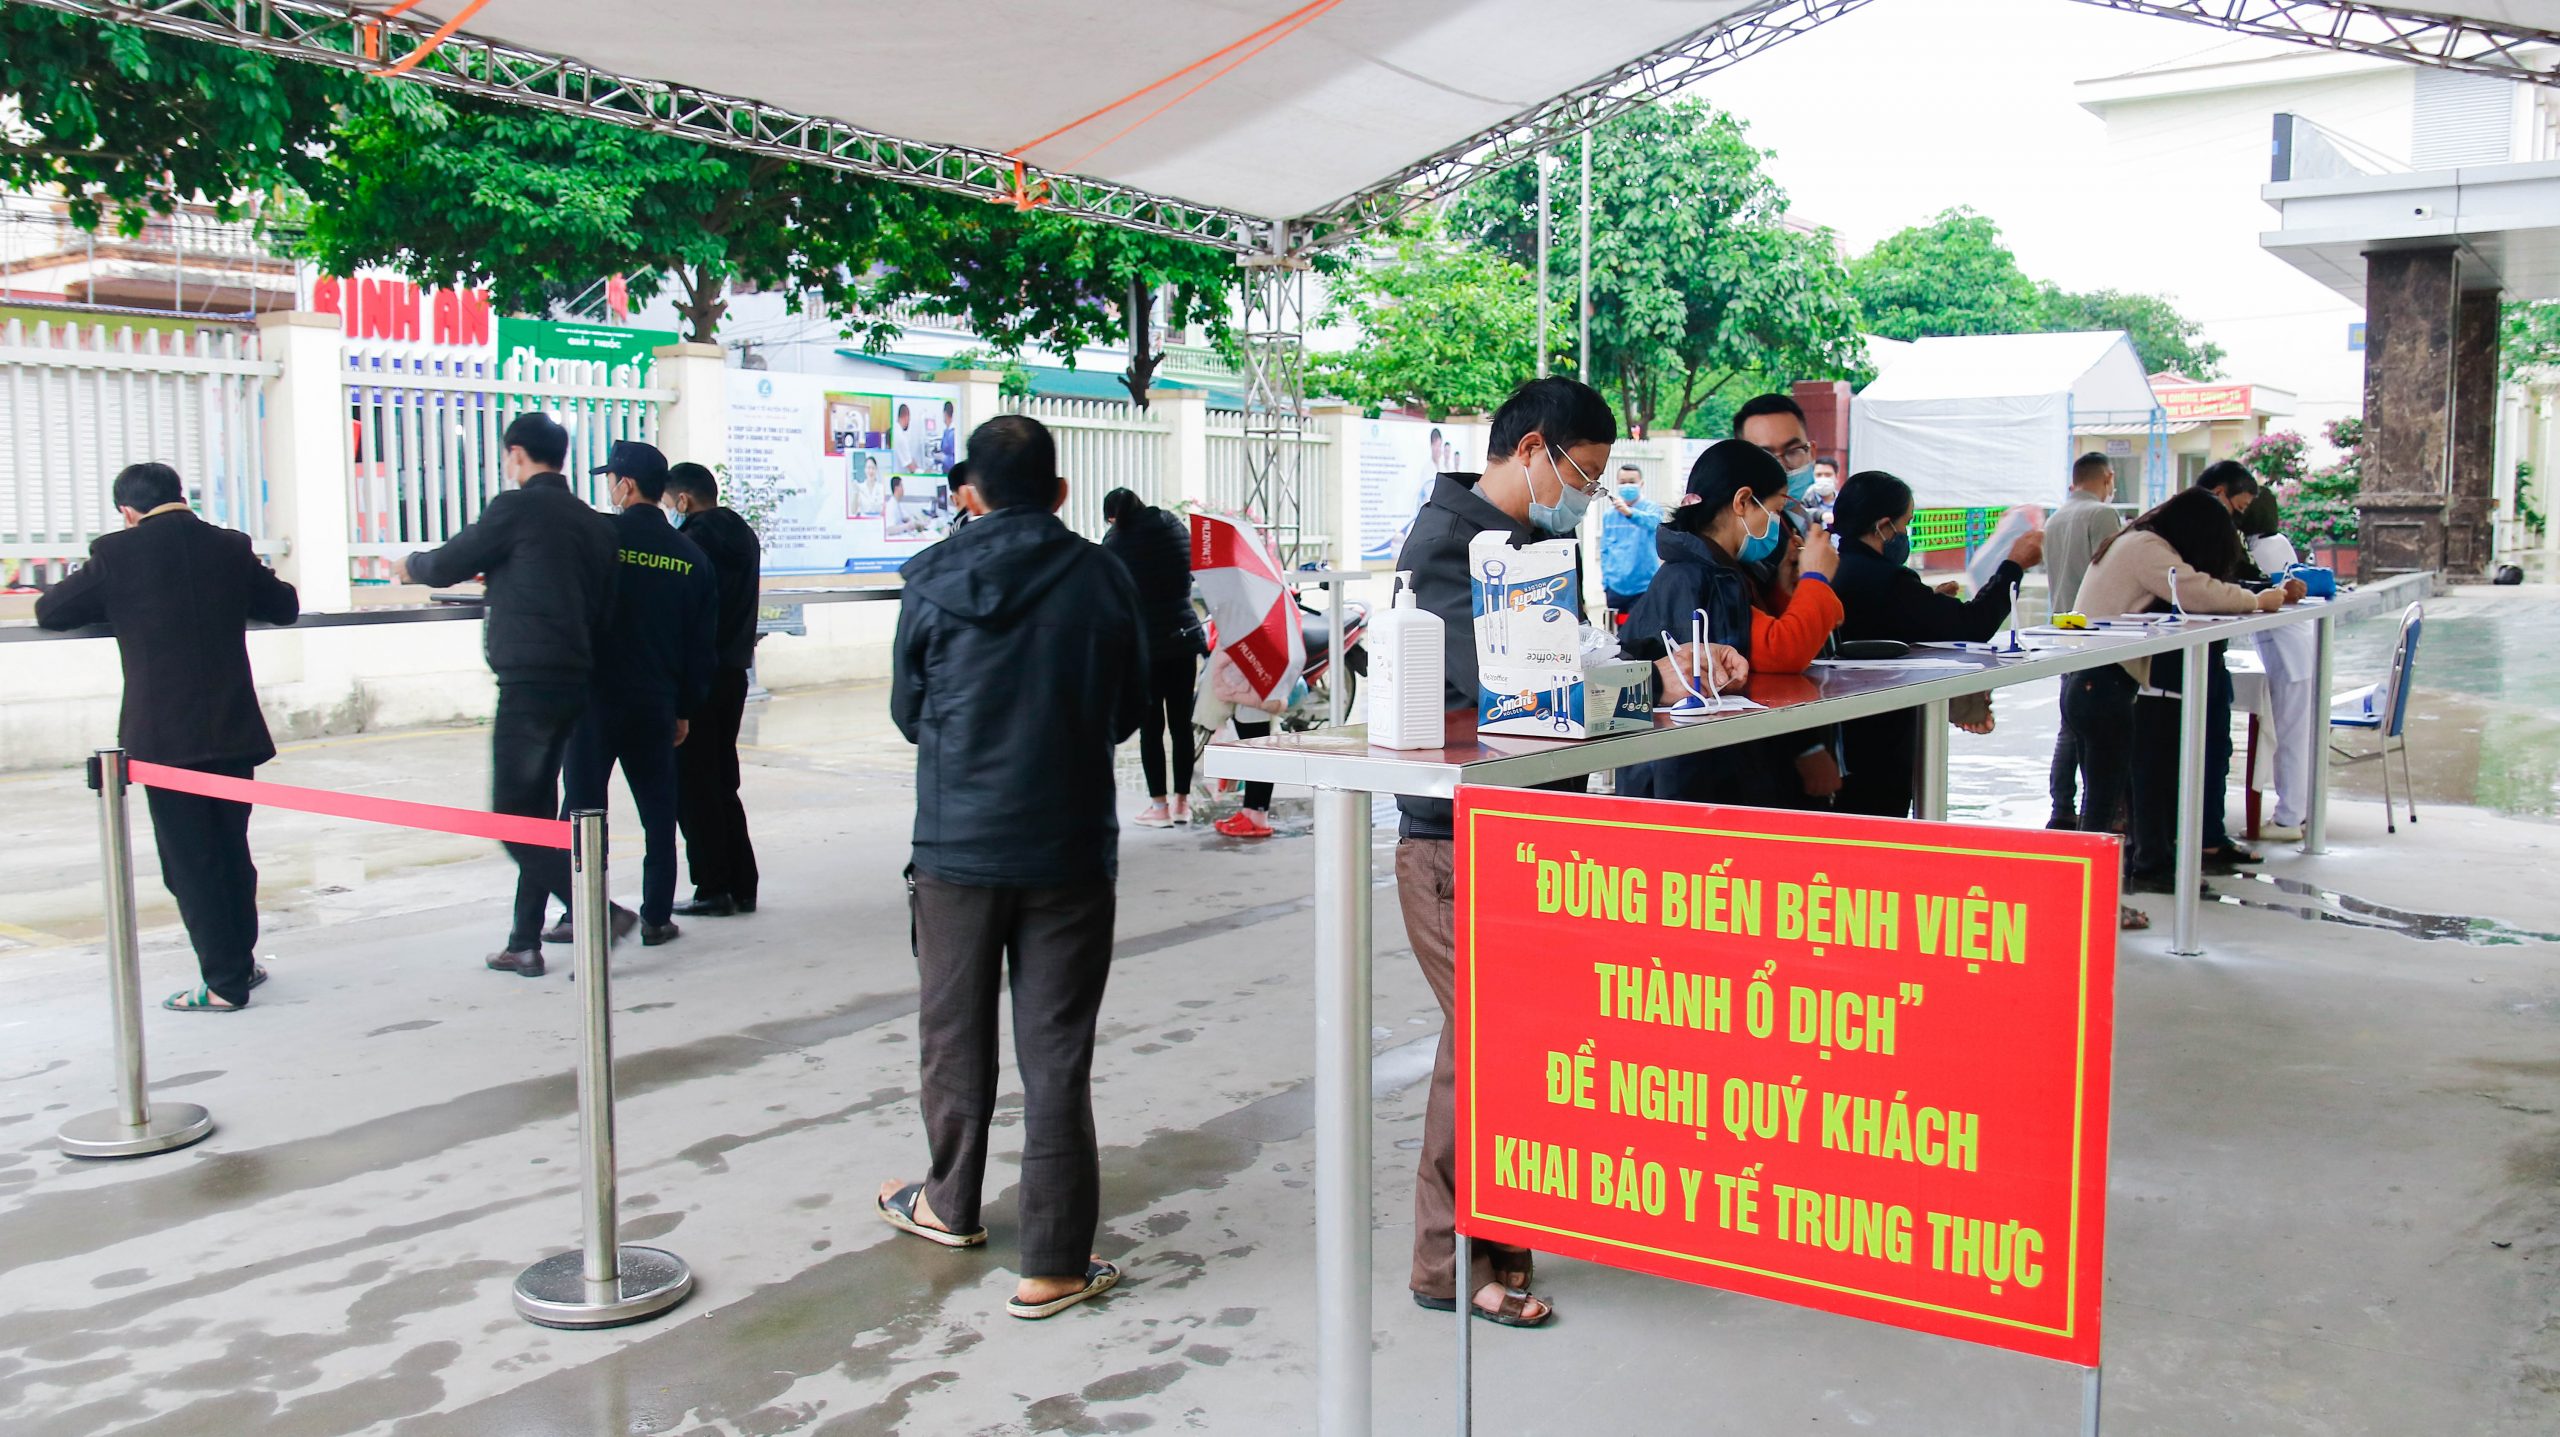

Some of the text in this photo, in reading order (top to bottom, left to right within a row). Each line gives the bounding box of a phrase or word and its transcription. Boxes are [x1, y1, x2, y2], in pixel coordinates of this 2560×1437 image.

[433, 287, 490, 346] AN
[618, 549, 693, 576] SECURITY
[1662, 858, 1762, 937] BIẾN
[1777, 872, 1900, 956] BỆNH
[1916, 886, 2027, 974] VIỆN
[1594, 957, 1732, 1034] THÀNH
[1747, 959, 1778, 1039] Ổ
[1546, 1038, 1979, 1172] ĐỀ NGHỊ QUÝ KHÁCH
[1495, 1135, 2045, 1295] KHAI BÁO Y TẾ TRUNG THỰC
